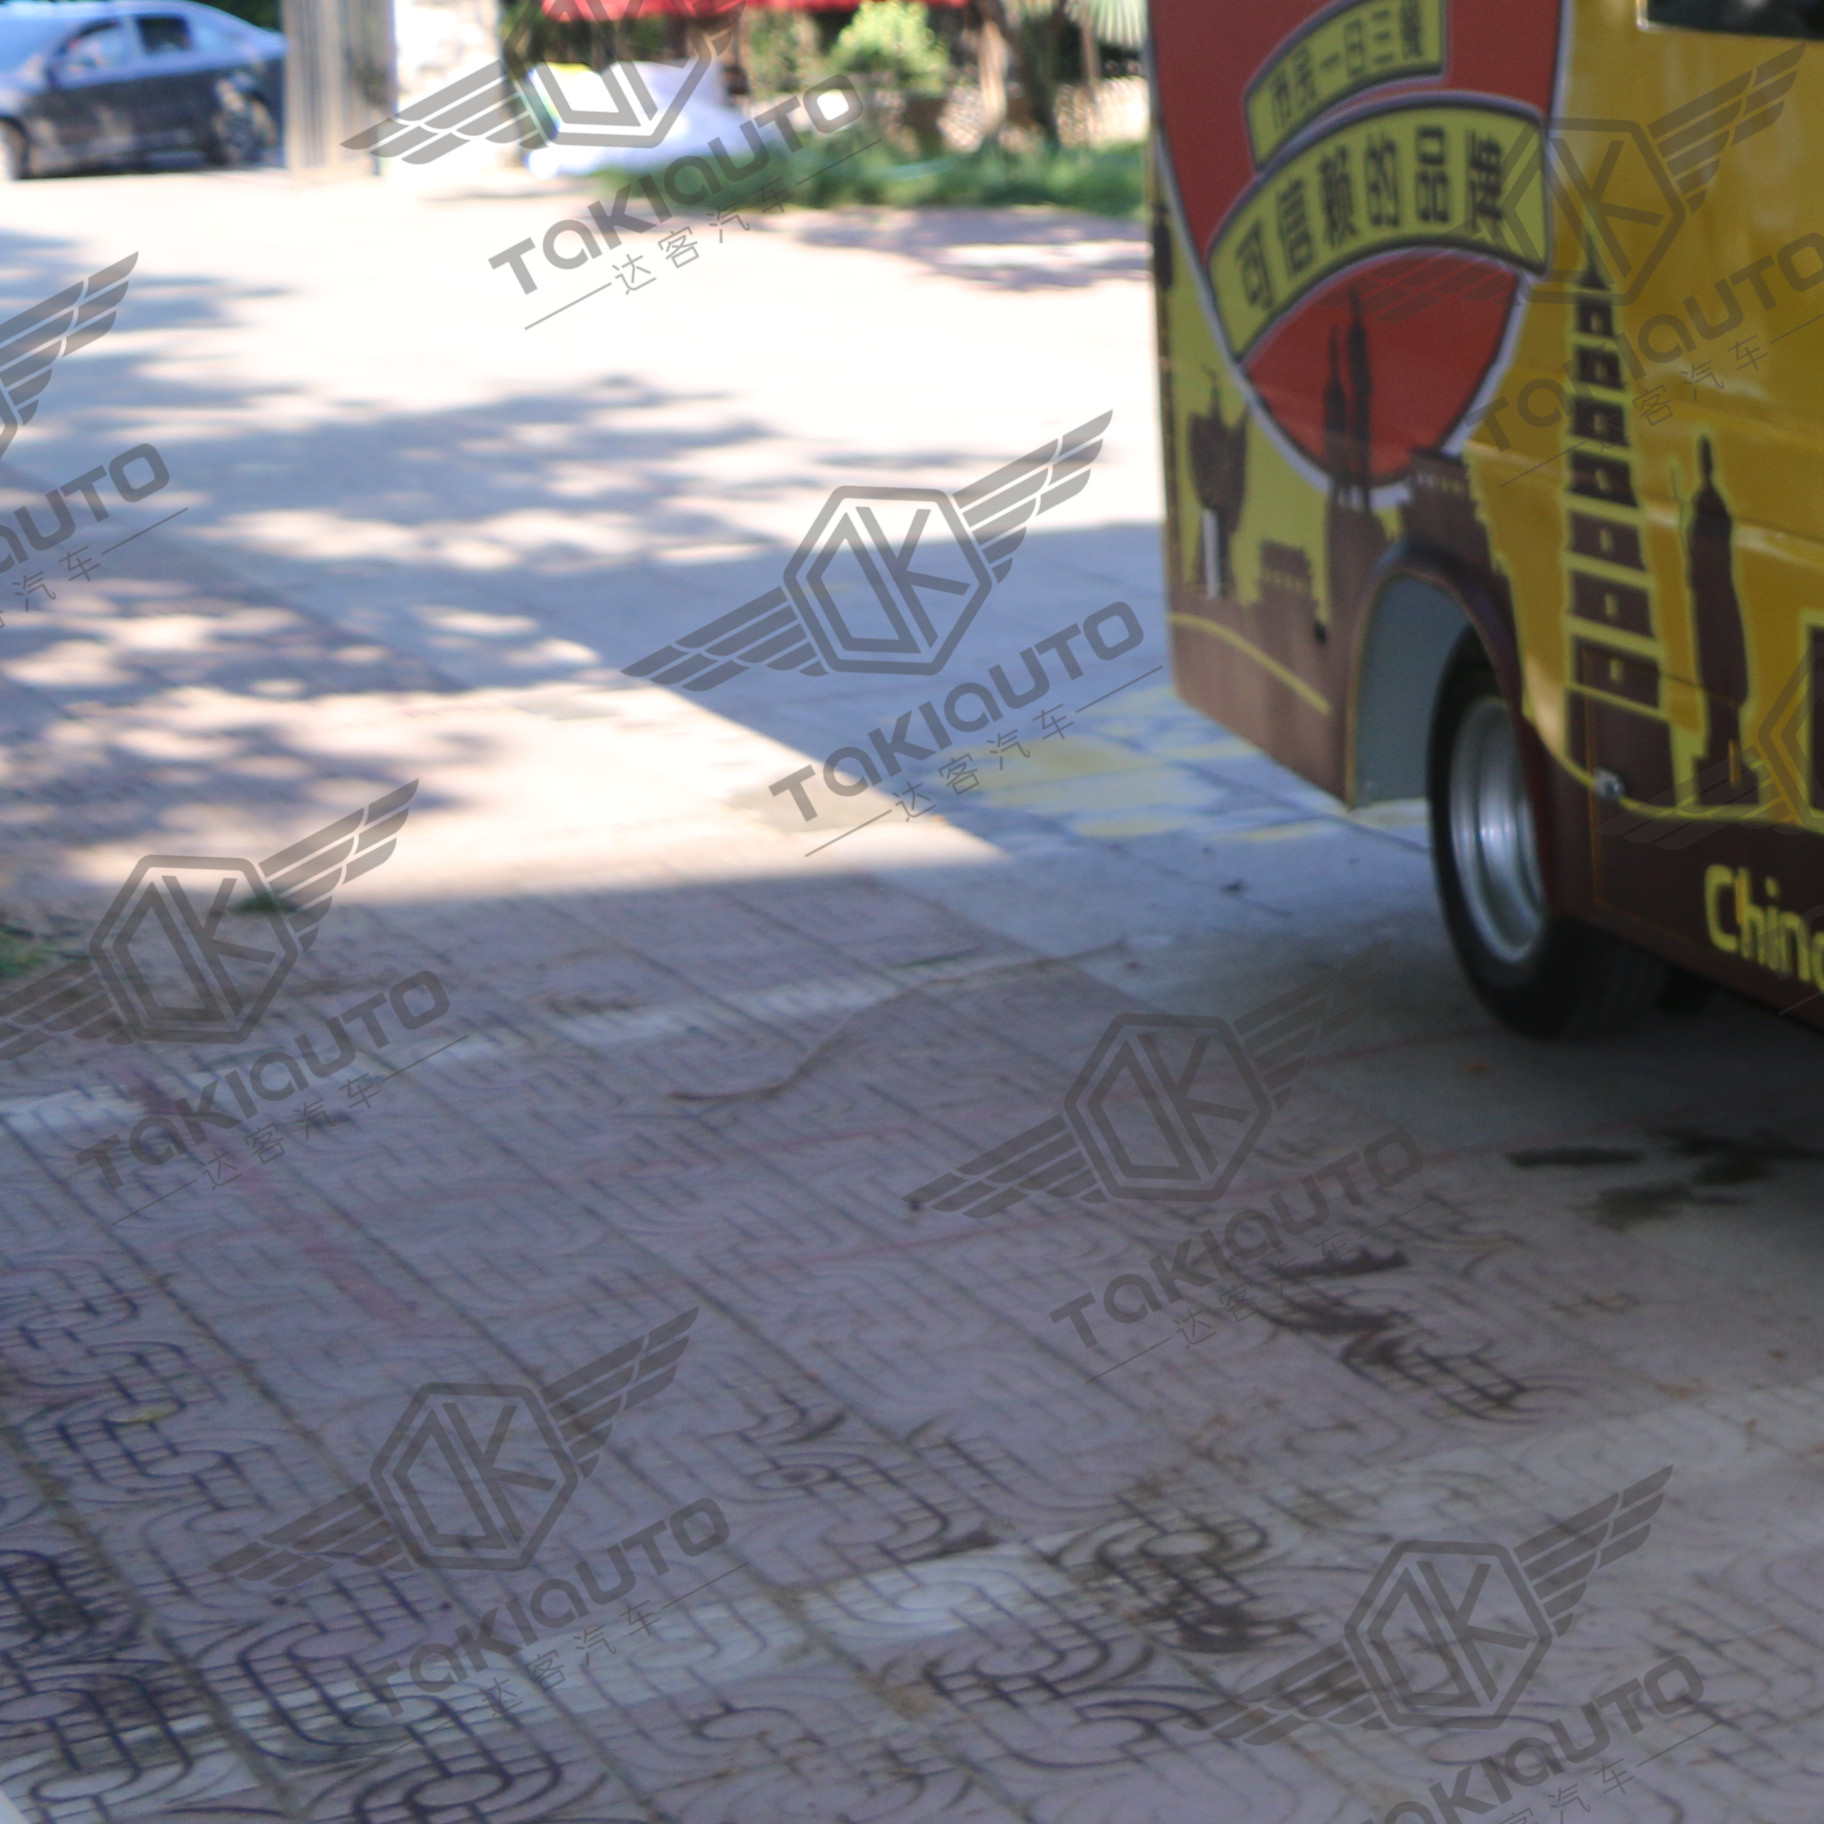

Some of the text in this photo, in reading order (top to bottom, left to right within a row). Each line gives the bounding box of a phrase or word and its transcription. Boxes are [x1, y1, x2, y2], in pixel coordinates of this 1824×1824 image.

[1235, 124, 1506, 313] 可信赖的品牌
